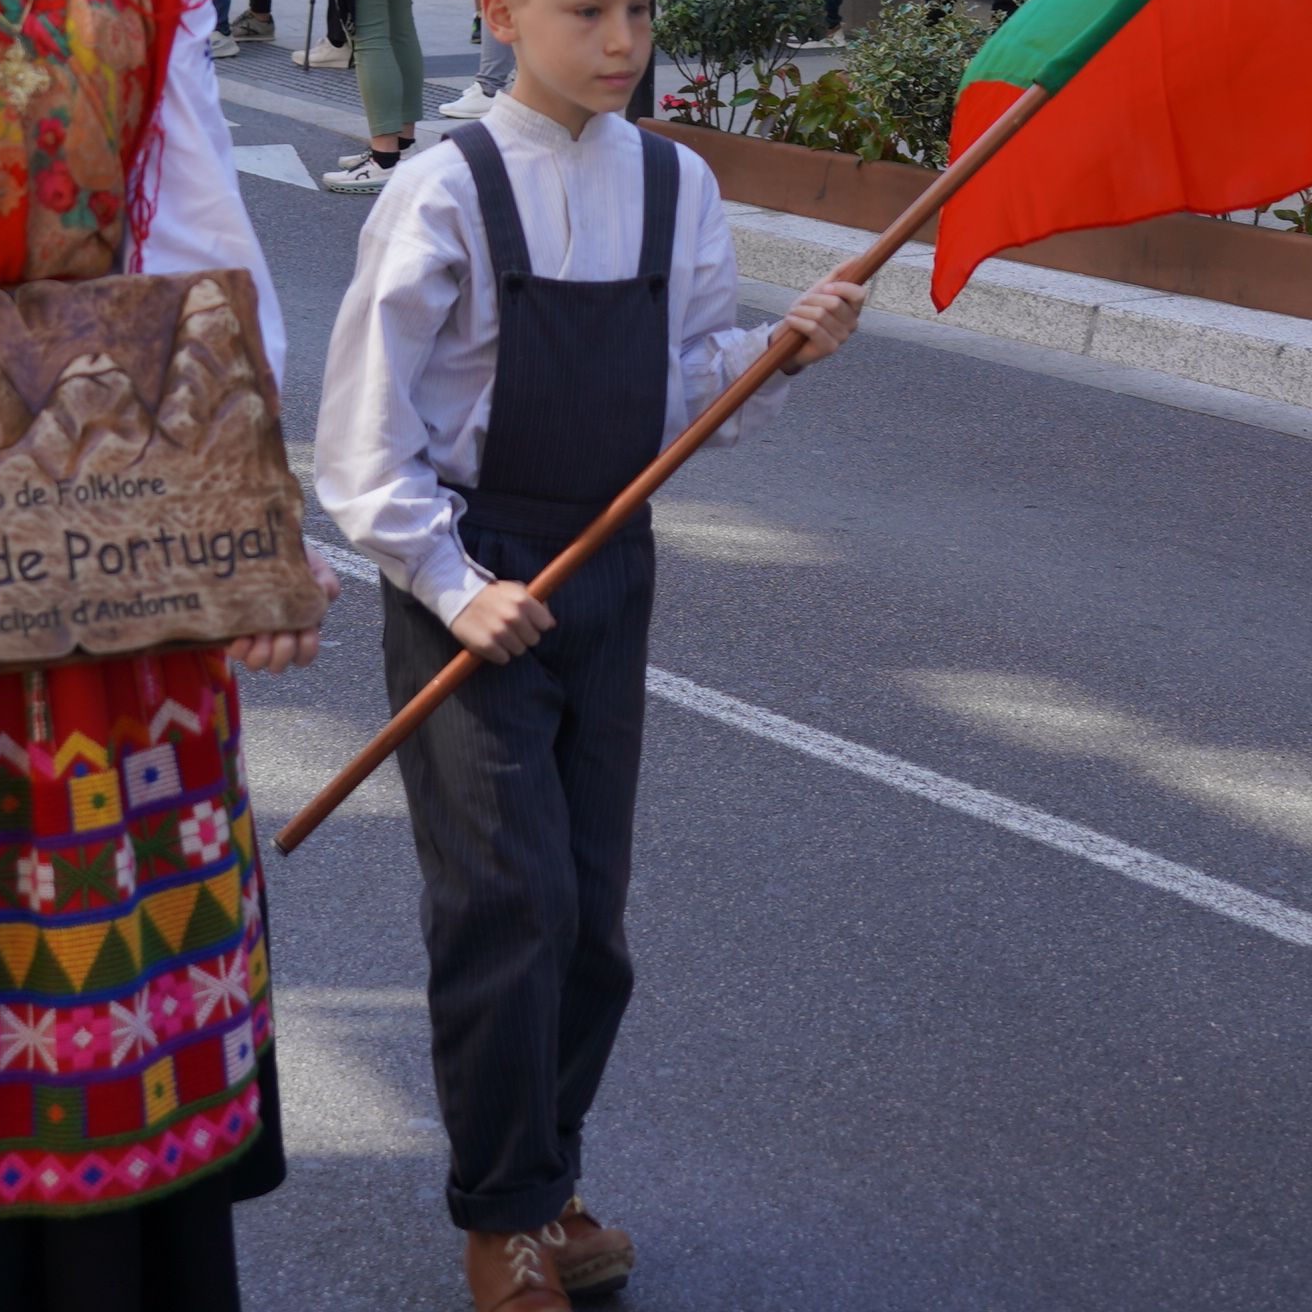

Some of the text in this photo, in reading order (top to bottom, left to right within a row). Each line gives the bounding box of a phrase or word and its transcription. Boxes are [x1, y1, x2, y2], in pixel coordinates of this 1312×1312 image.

[15, 483, 47, 507] de
[57, 472, 167, 504] Folklore
[72, 589, 201, 627] d'Andorra
